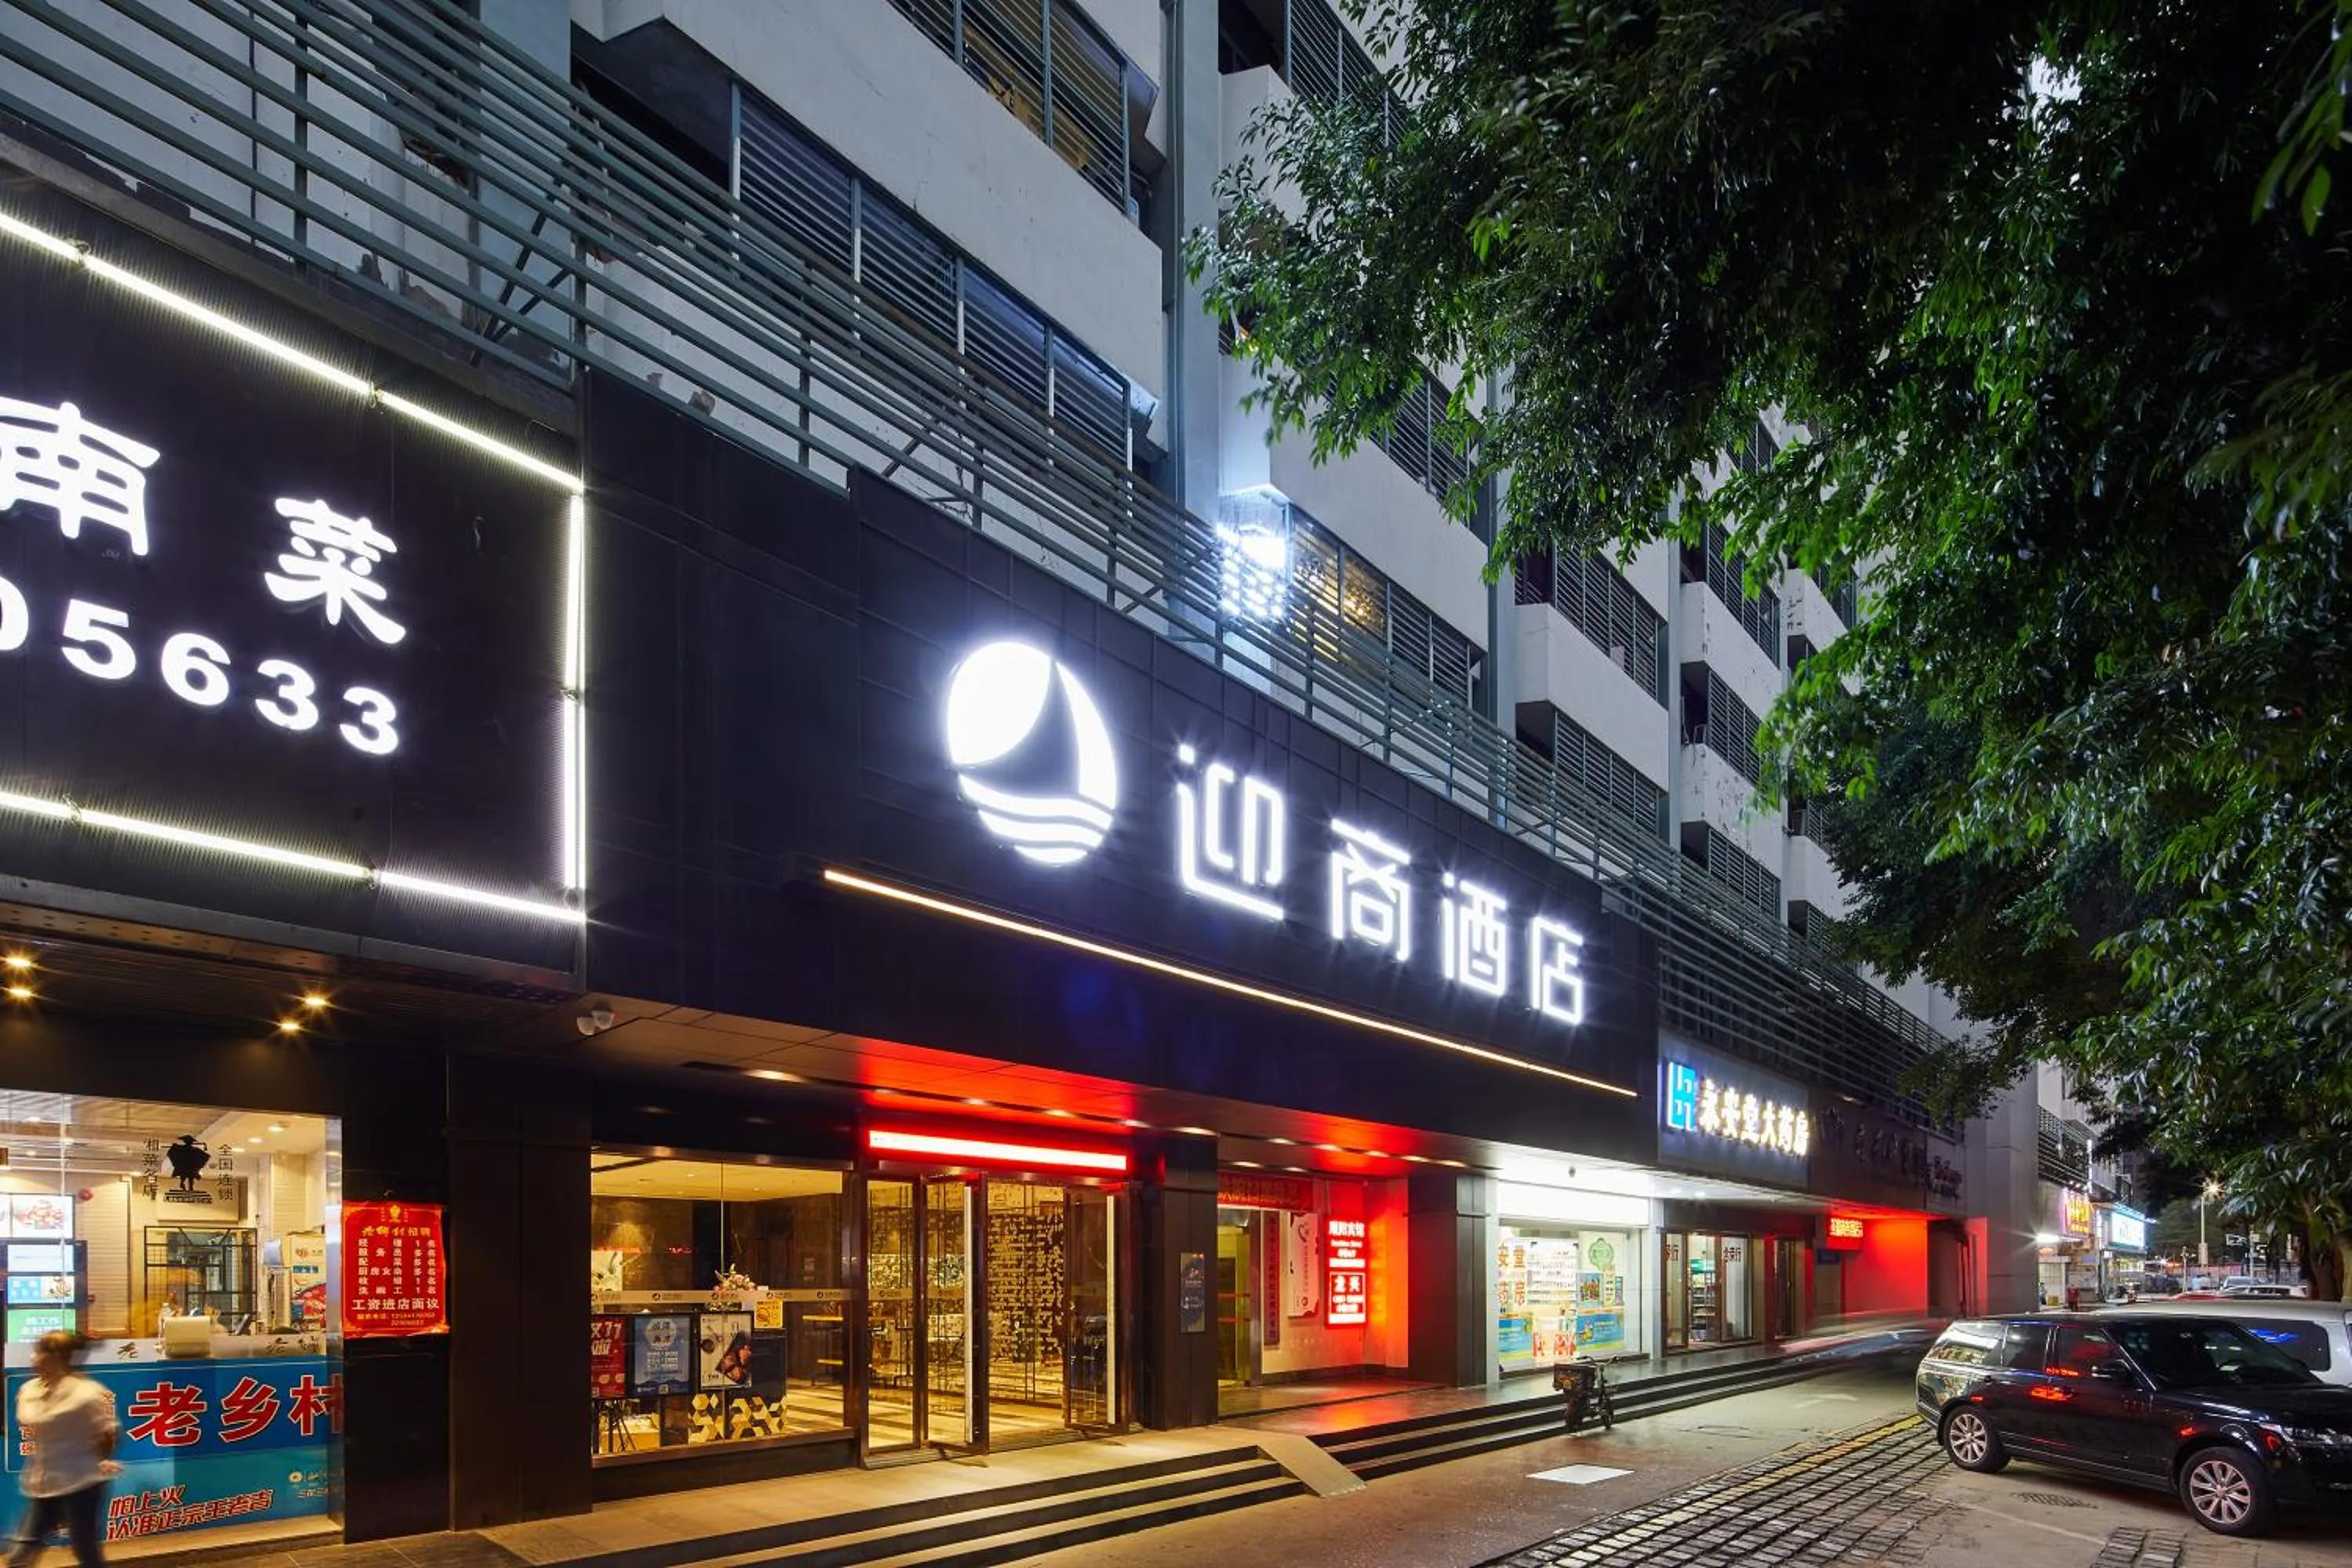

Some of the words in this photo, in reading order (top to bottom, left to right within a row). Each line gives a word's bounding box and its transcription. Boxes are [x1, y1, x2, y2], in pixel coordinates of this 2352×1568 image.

[1176, 744, 1584, 1025] 迎商酒店
[351, 1298, 440, 1310] 工资进店面议
[107, 1489, 274, 1542] 认准正宗王老吉
[108, 1484, 186, 1519] 怕上火
